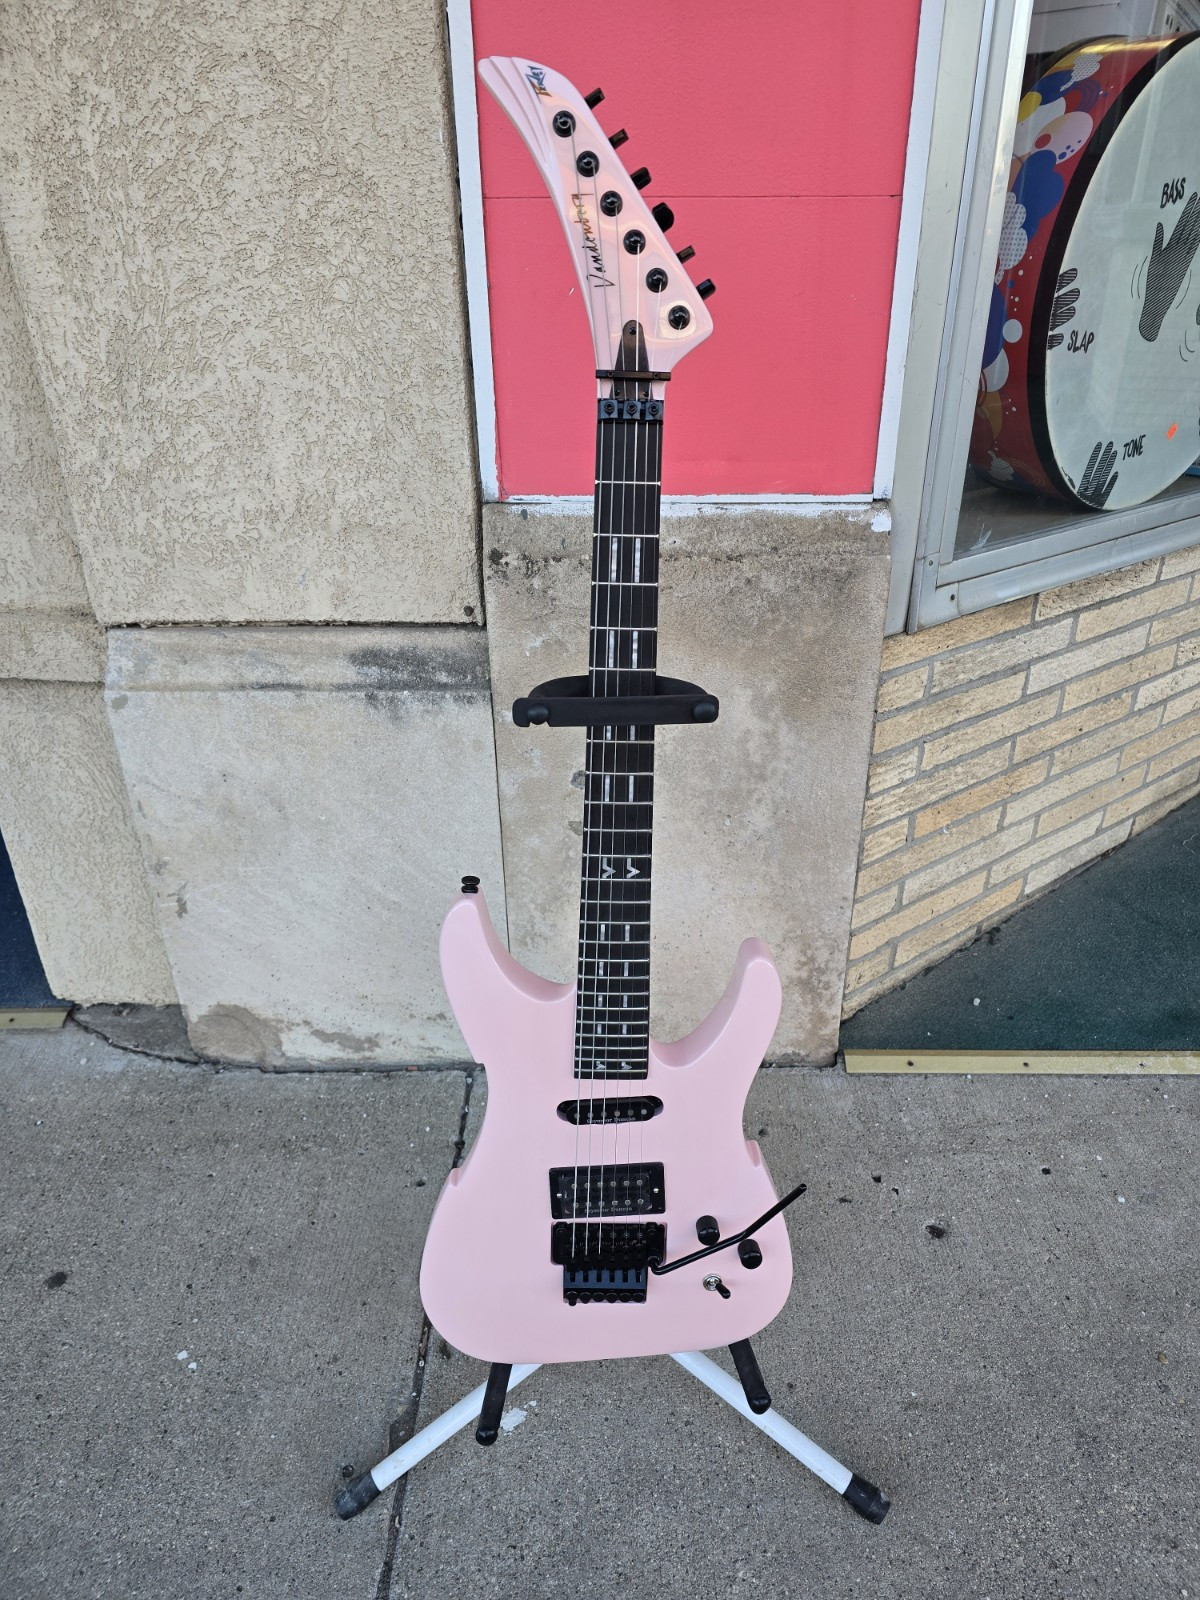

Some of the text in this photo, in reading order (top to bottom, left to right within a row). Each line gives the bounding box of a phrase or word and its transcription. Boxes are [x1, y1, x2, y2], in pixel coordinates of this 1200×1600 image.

[1160, 177, 1186, 209] BASS
[1067, 329, 1095, 354] SLAP
[1122, 434, 1146, 460] TONE
